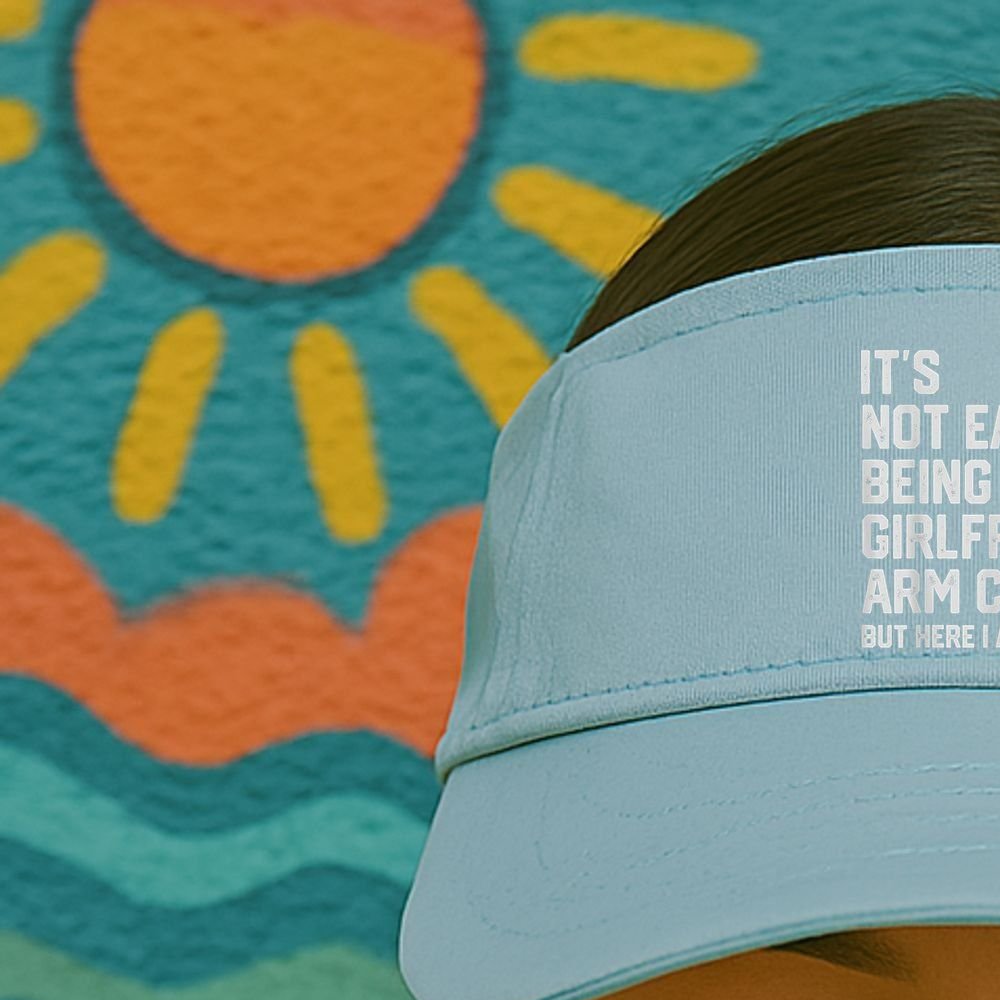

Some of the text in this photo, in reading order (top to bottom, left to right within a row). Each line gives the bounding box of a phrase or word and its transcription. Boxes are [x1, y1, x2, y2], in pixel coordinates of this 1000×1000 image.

[860, 349, 940, 395] IT'S
[861, 404, 949, 449] NOT
[861, 459, 992, 504] BEING
[862, 569, 960, 614] ARM
[861, 624, 907, 648] BUT
[915, 624, 975, 648] HERE
[982, 624, 989, 648] I
